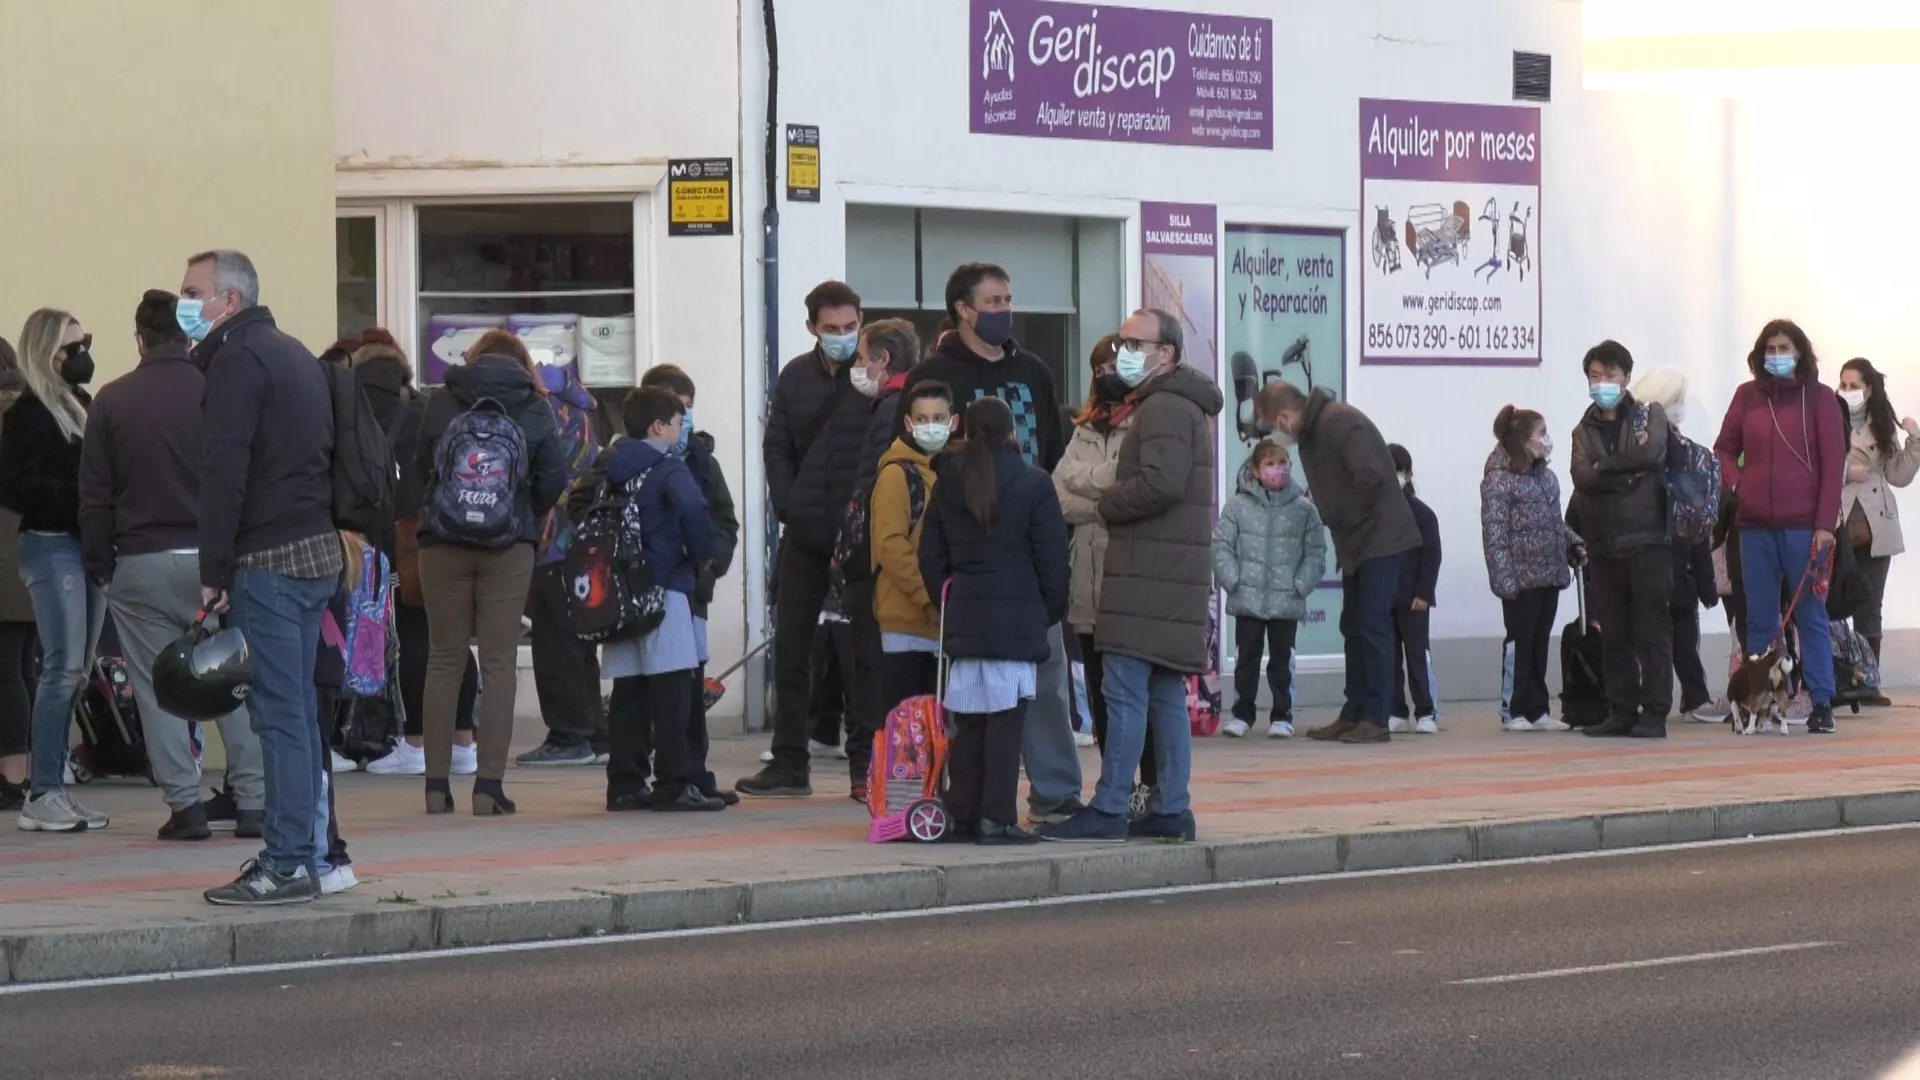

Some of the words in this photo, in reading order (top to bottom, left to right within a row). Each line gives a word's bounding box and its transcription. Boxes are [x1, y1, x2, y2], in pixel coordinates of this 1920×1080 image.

[1028, 8, 1098, 66] Geri
[1188, 22, 1236, 60] Cuidamos
[1239, 25, 1251, 61] de
[1254, 26, 1262, 62] ti
[1073, 44, 1176, 98] discap
[1235, 70, 1248, 84] 073
[1248, 71, 1262, 85] 290
[983, 87, 1013, 106] Ayudas
[1216, 86, 1229, 100] 601
[984, 108, 1016, 124] técnicas
[1036, 101, 1076, 131] Alquiler
[1077, 106, 1106, 129] venta
[1108, 111, 1116, 136] y
[1117, 107, 1171, 137] reparación
[1368, 113, 1439, 168] Alquiler
[1445, 128, 1475, 170] por
[1481, 129, 1535, 162] meses
[1169, 213, 1191, 228] SILLA
[1146, 231, 1213, 246] SALVAESCALERAS
[1297, 252, 1334, 278] venta
[1238, 292, 1247, 321] y
[1253, 284, 1328, 322] Reparación
[1402, 290, 1502, 316] www.geridiscap.com
[1368, 323, 1393, 349] 856
[1396, 323, 1420, 349] 073
[1423, 325, 1447, 349] 290
[1458, 325, 1480, 350] 601
[1486, 325, 1508, 349] 162
[1511, 325, 1535, 350] 334
